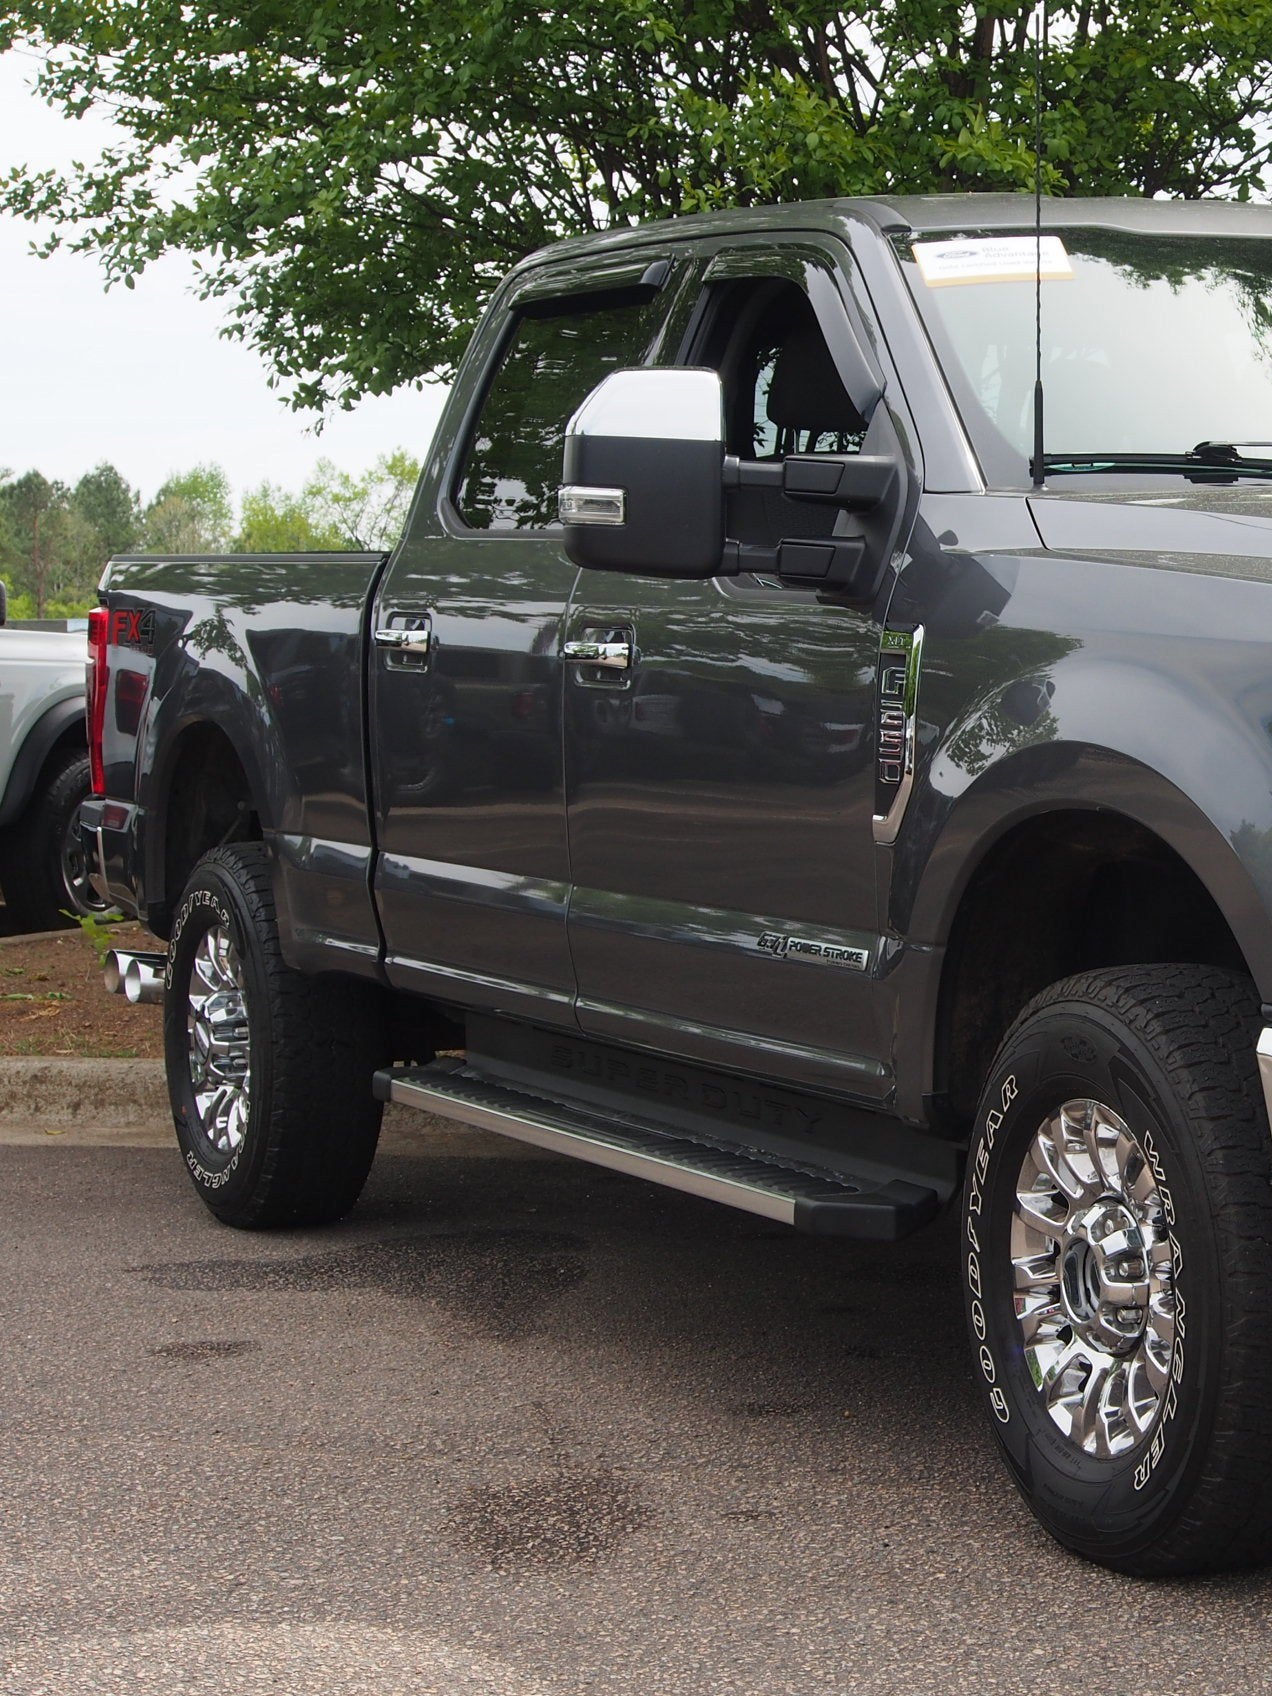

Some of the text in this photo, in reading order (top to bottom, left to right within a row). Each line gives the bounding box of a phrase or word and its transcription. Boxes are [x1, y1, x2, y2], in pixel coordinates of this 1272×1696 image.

[112, 608, 155, 647] FX4
[166, 890, 230, 990] GOODYEAR
[788, 940, 822, 957] POWER
[822, 946, 864, 964] STROKE
[549, 1044, 823, 1134] SUPER DUTY
[967, 1075, 1018, 1423] GOODYEAR
[1134, 1130, 1187, 1491] WRANGLER
